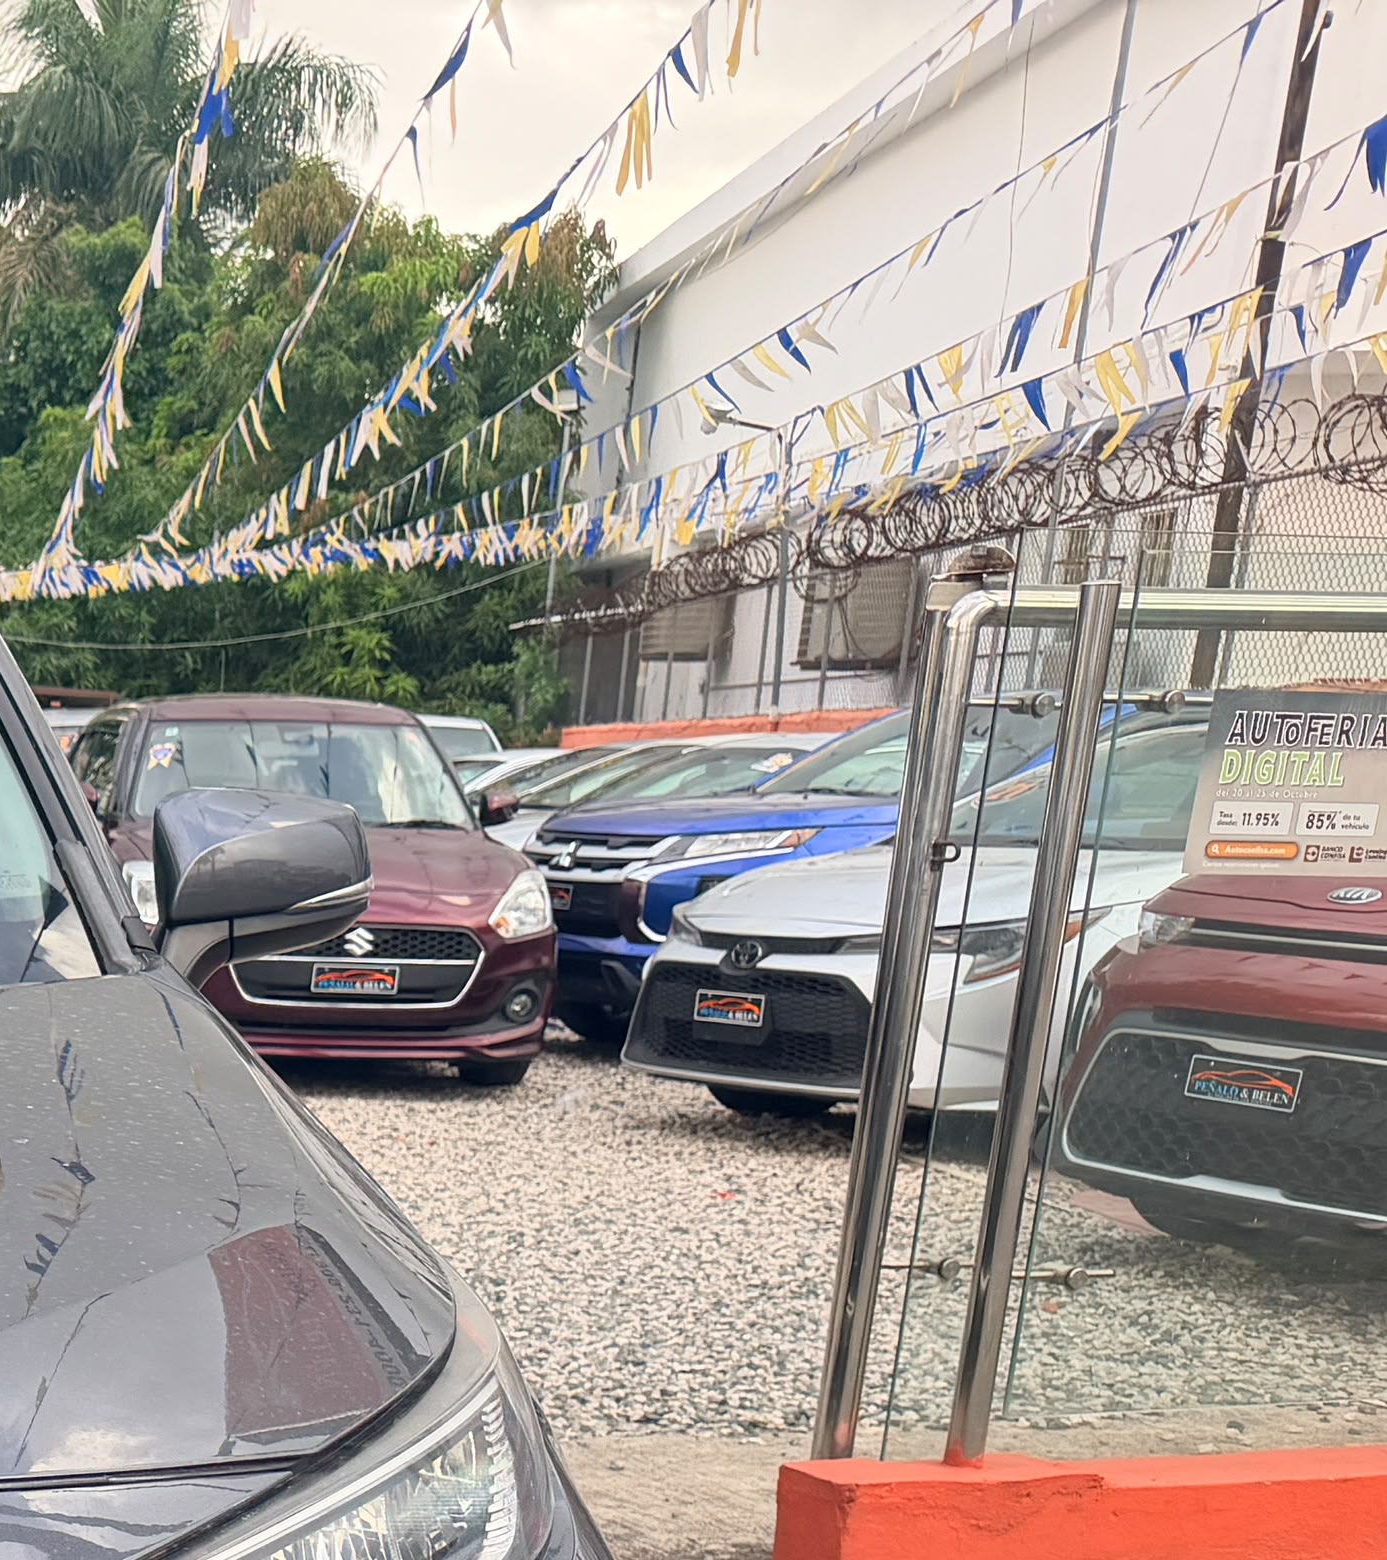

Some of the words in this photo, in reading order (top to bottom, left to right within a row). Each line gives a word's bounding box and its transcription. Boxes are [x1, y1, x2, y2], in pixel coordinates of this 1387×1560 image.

[1225, 709, 1387, 749] AUTOFERIA
[1218, 748, 1345, 787] DIGITAL
[1283, 789, 1318, 799] Octubre
[1242, 812, 1280, 827] 11.95%
[1305, 811, 1338, 830] 85%
[1239, 1087, 1249, 1099] &
[1252, 1088, 1290, 1105] BELEN
